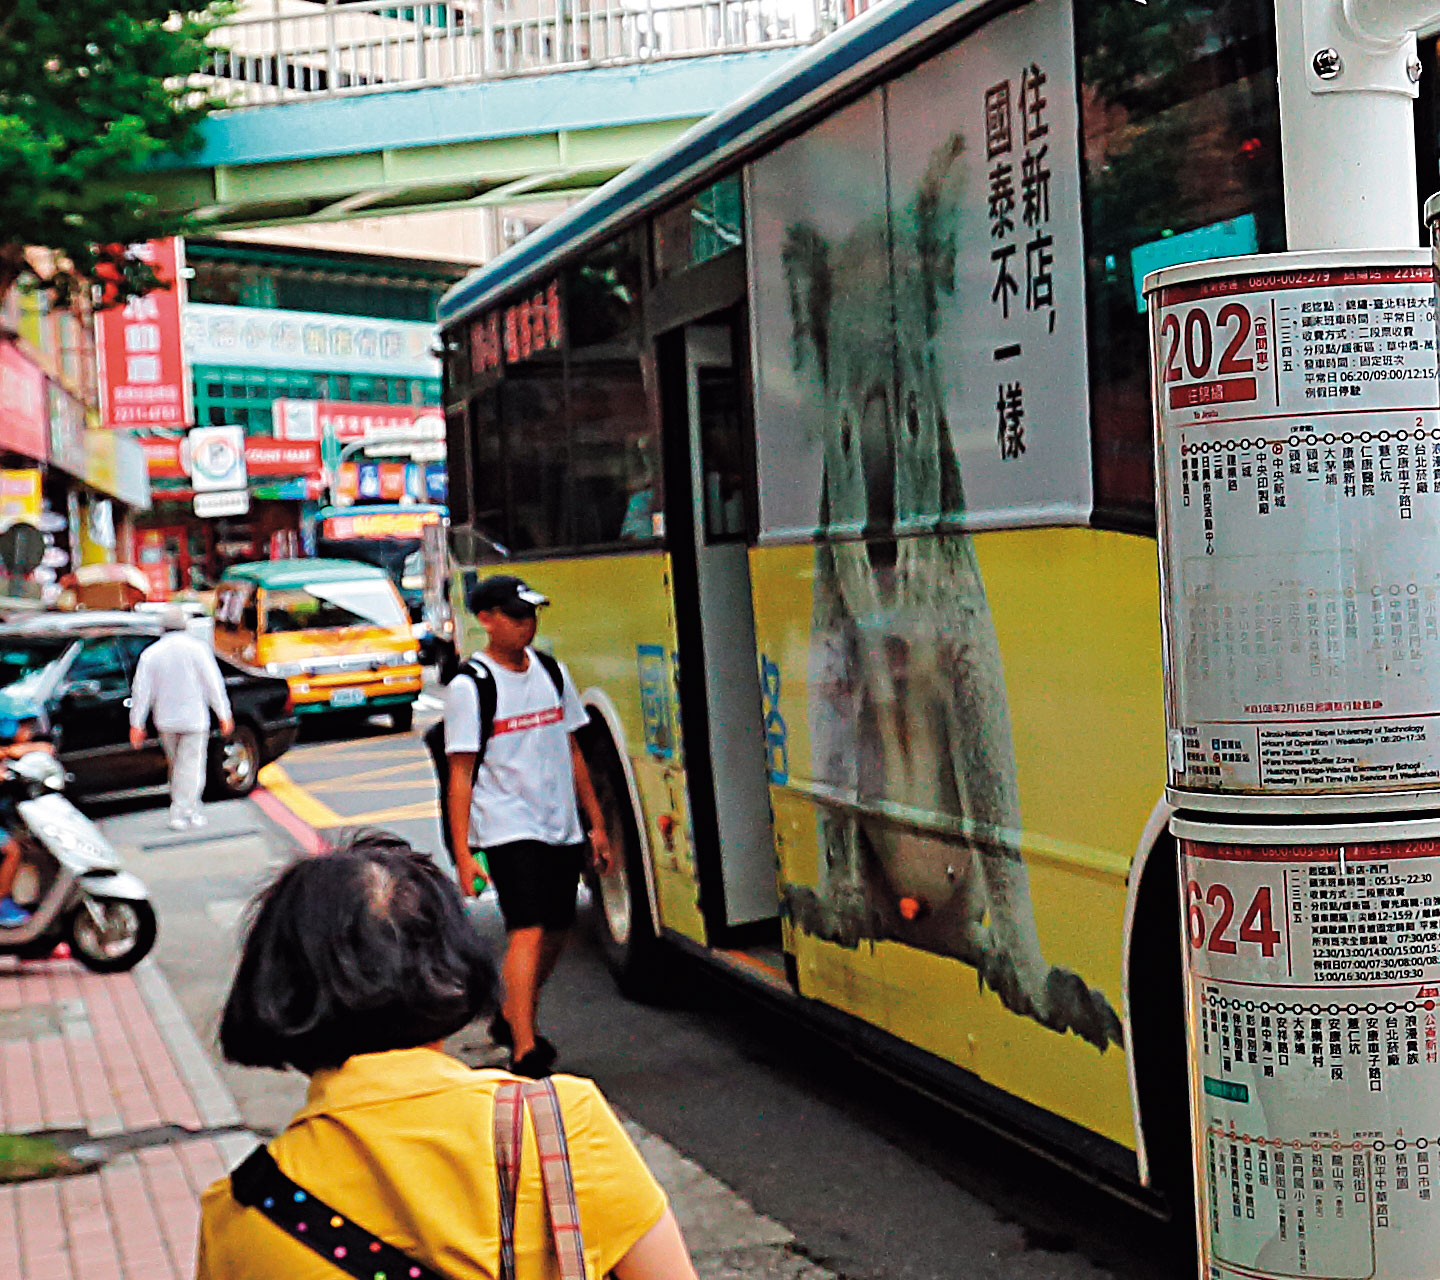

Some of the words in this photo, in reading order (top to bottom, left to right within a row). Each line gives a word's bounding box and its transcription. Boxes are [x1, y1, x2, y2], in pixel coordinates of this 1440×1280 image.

[984, 78, 1026, 462] 國泰不一樣
[1162, 302, 1254, 383] 202
[1188, 880, 1281, 958] 624
